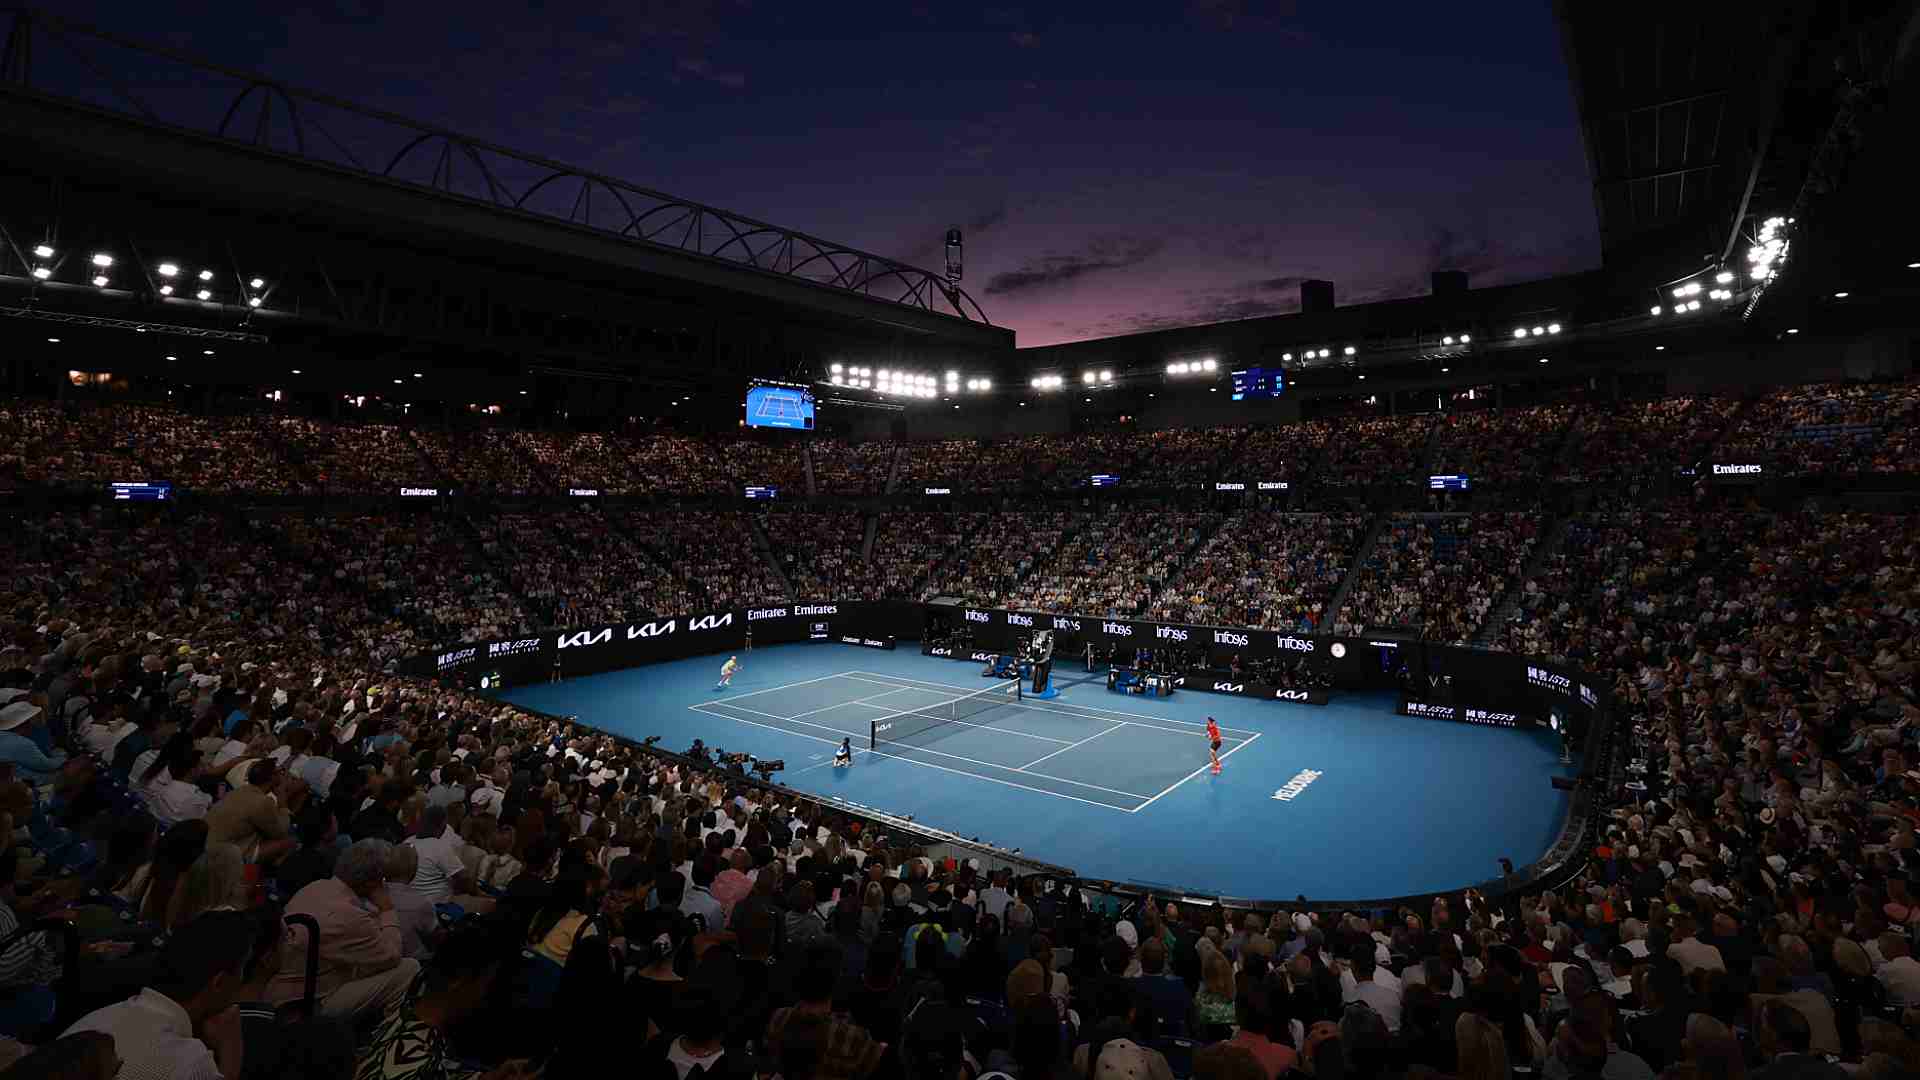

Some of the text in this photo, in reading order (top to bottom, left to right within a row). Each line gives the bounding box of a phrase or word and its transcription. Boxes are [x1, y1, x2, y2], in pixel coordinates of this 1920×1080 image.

[1712, 464, 1762, 474] Emirates
[401, 488, 437, 496] Emirates
[1216, 483, 1245, 491] Emirates
[1258, 482, 1288, 490] Emirates
[748, 608, 787, 620] Emirates
[794, 604, 837, 616] Emirates
[966, 609, 990, 623] Infosys
[1008, 613, 1033, 627] Infosys
[1103, 621, 1133, 637] Infosys
[1156, 625, 1188, 642] Infosys
[1214, 629, 1248, 647] Infosys
[1277, 635, 1314, 653] Infosys
